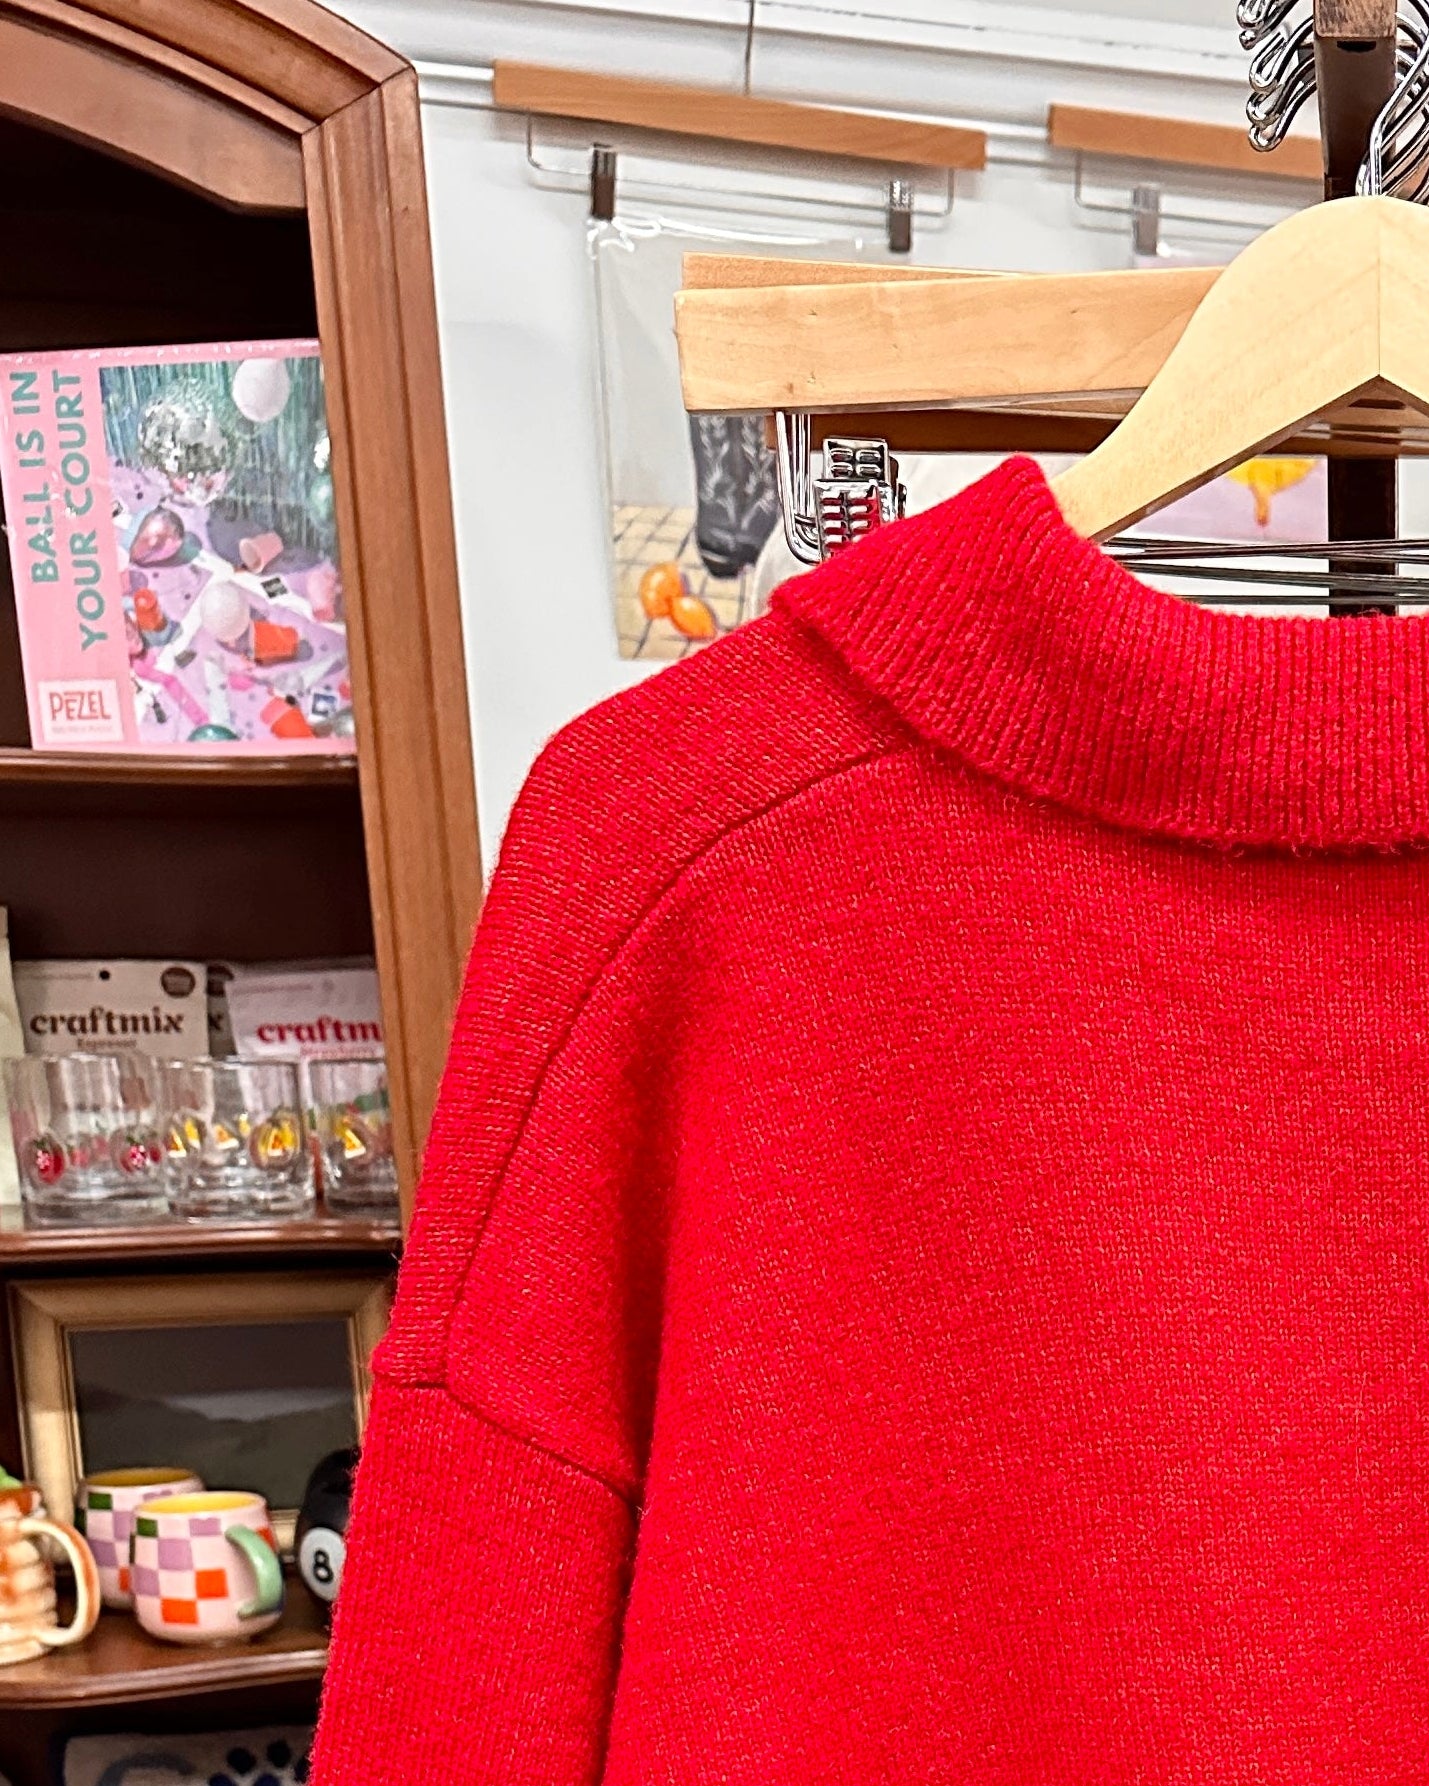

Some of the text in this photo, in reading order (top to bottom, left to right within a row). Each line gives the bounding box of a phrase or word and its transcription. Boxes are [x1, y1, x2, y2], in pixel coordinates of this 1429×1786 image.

[9, 370, 60, 585] BALL IS IN
[51, 368, 109, 652] YOUR COURT
[48, 689, 113, 722] PEZEL
[29, 1004, 185, 1036] craftmix
[311, 1549, 334, 1585] 8
